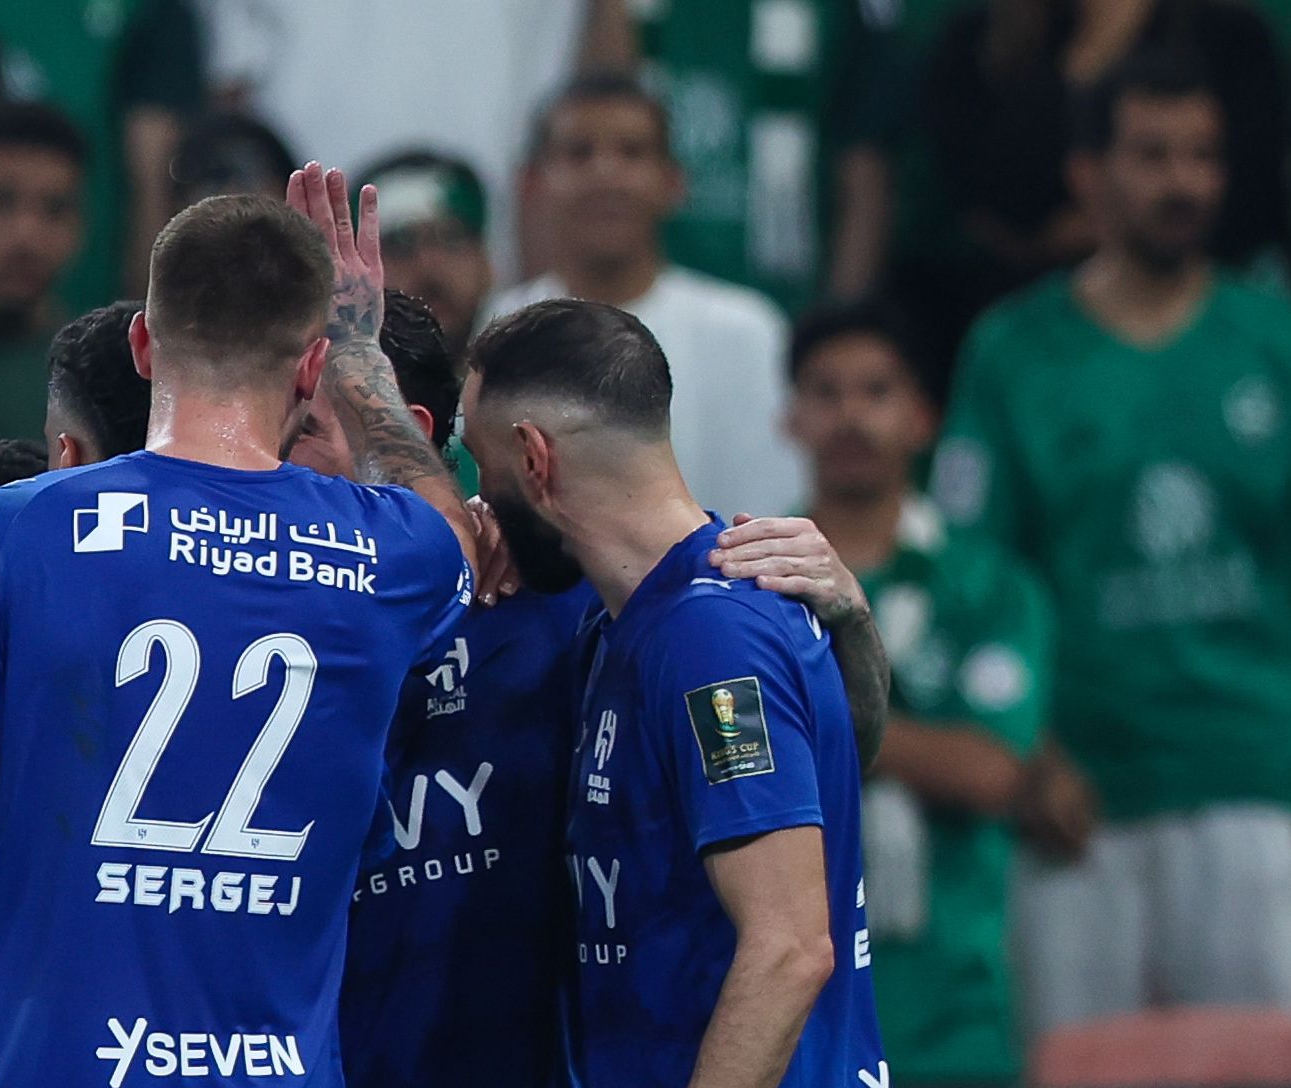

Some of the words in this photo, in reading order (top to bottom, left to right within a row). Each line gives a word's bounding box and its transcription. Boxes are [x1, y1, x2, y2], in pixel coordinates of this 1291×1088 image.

[170, 506, 278, 545] الرياض
[288, 521, 379, 565] بنك
[168, 531, 278, 577] Riyad
[288, 549, 378, 595] Bank
[90, 618, 318, 862] 22
[94, 861, 302, 917] SERGEJ
[369, 847, 501, 895] GROUP
[578, 943, 628, 965] OUP
